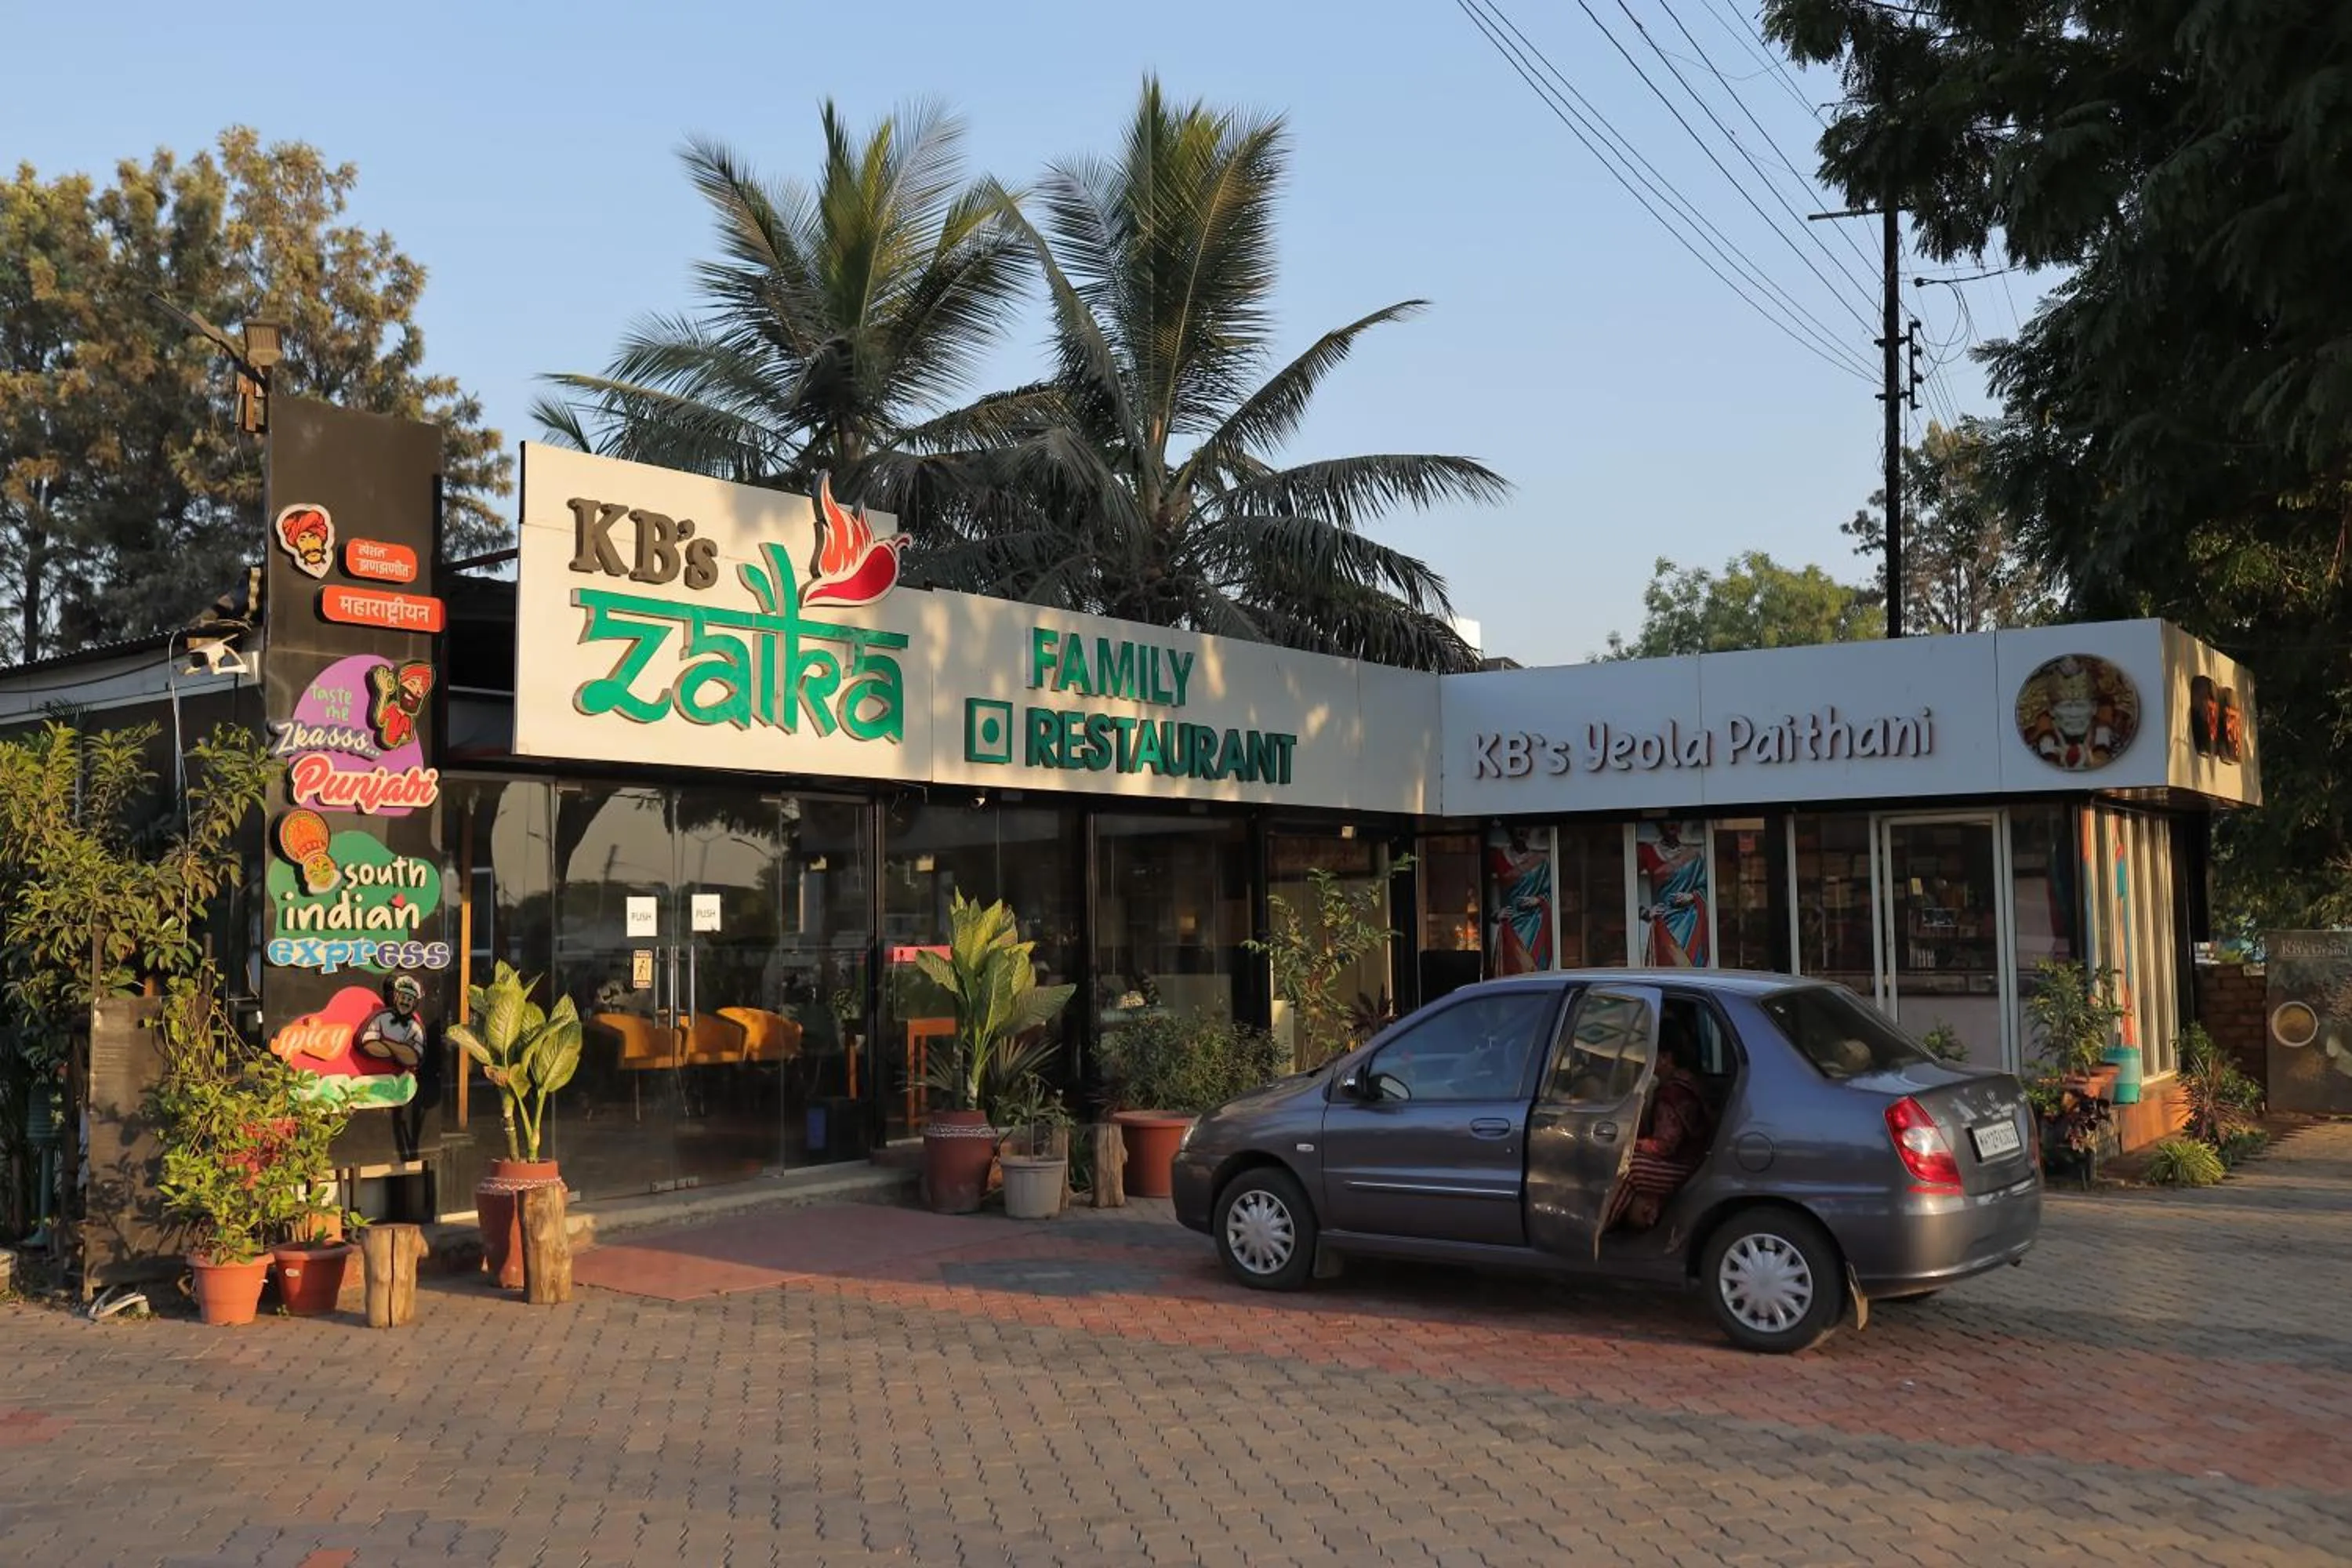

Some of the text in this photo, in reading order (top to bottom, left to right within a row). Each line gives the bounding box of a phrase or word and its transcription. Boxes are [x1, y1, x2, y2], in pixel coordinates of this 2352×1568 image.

[567, 498, 718, 590] KB's
[338, 594, 430, 625] महाराष्ट्रीयन
[1025, 626, 1195, 706] FAMILY
[1025, 706, 1298, 785] RESTAURANT
[1472, 704, 1932, 780] KB's Yeola Paithani
[292, 754, 438, 814] Punjabi
[344, 855, 427, 890] south
[285, 890, 420, 931] indian
[631, 911, 652, 921] PUSH
[696, 909, 716, 918] PUSH
[267, 937, 451, 975] express
[278, 1018, 350, 1058] spicy
